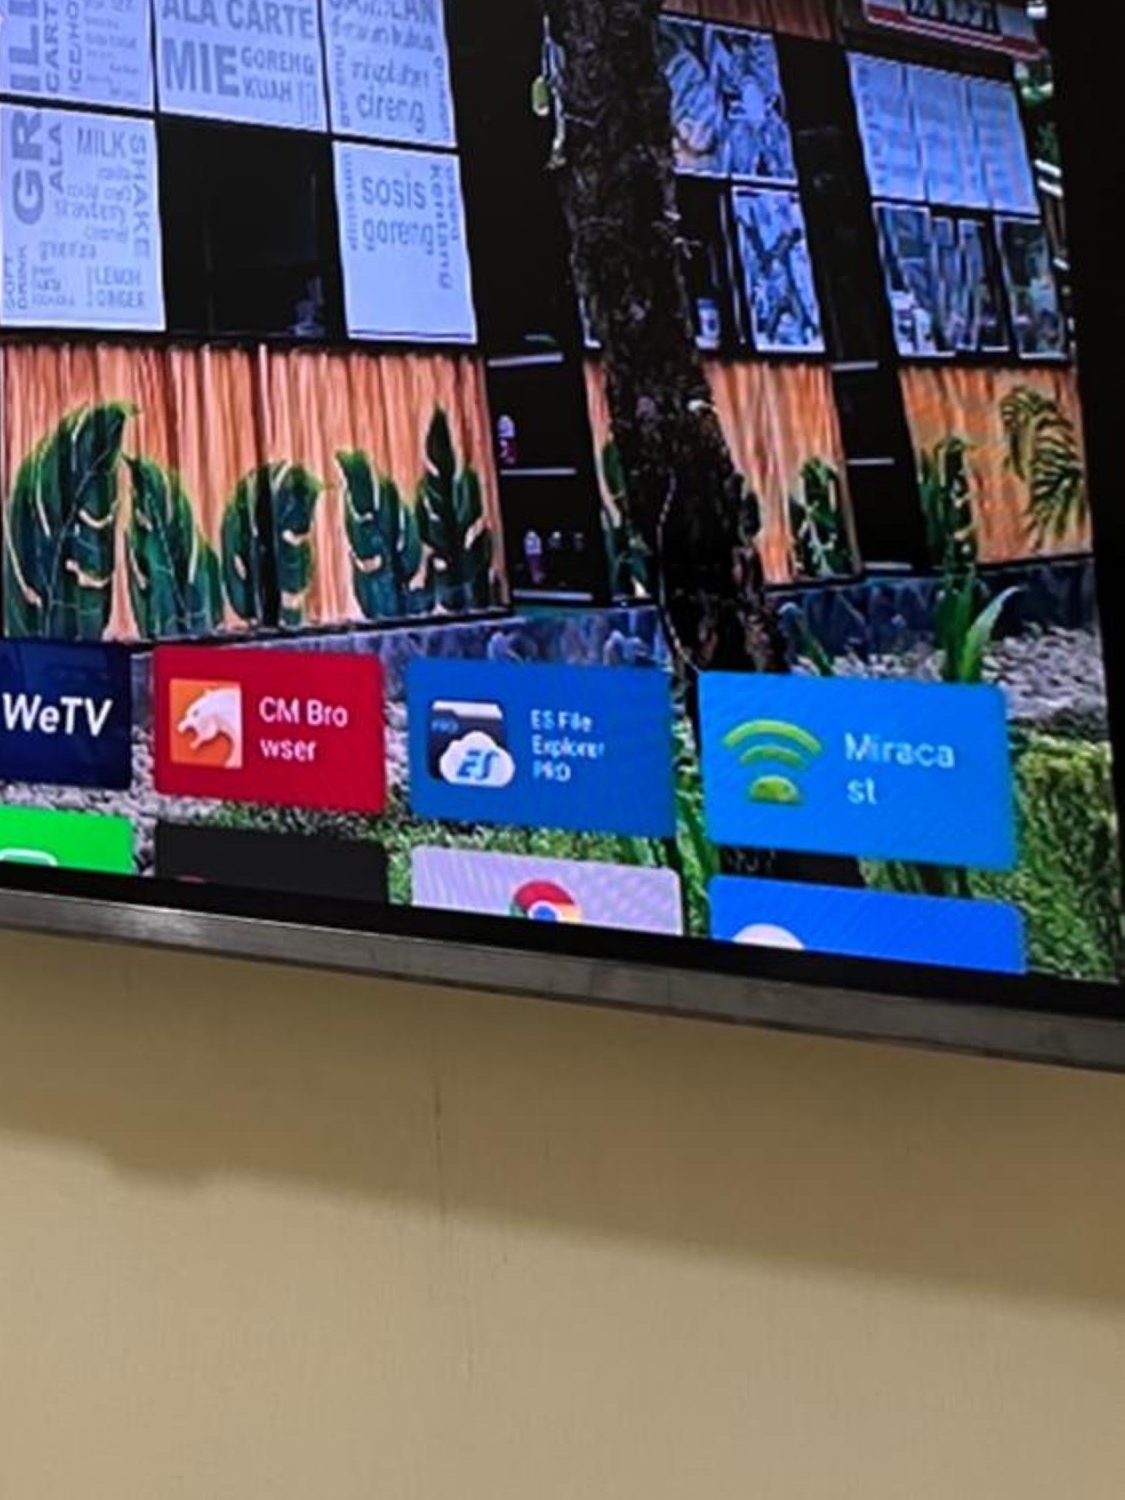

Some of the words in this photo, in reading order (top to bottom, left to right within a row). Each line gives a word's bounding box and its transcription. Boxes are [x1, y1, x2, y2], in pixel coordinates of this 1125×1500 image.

[161, 37, 240, 99] MIE
[240, 46, 316, 76] GORENG
[48, 123, 64, 194] ALA
[76, 126, 126, 159] MILK
[130, 133, 151, 260] SHAKE
[361, 169, 427, 210] sosis
[363, 218, 434, 256] goreng
[2, 692, 113, 738] WeTV
[258, 695, 300, 726] CM
[305, 698, 349, 729] Bro
[530, 708, 556, 731] ES
[260, 737, 318, 763] wser
[843, 731, 957, 770] Miraca
[846, 776, 879, 806] st
